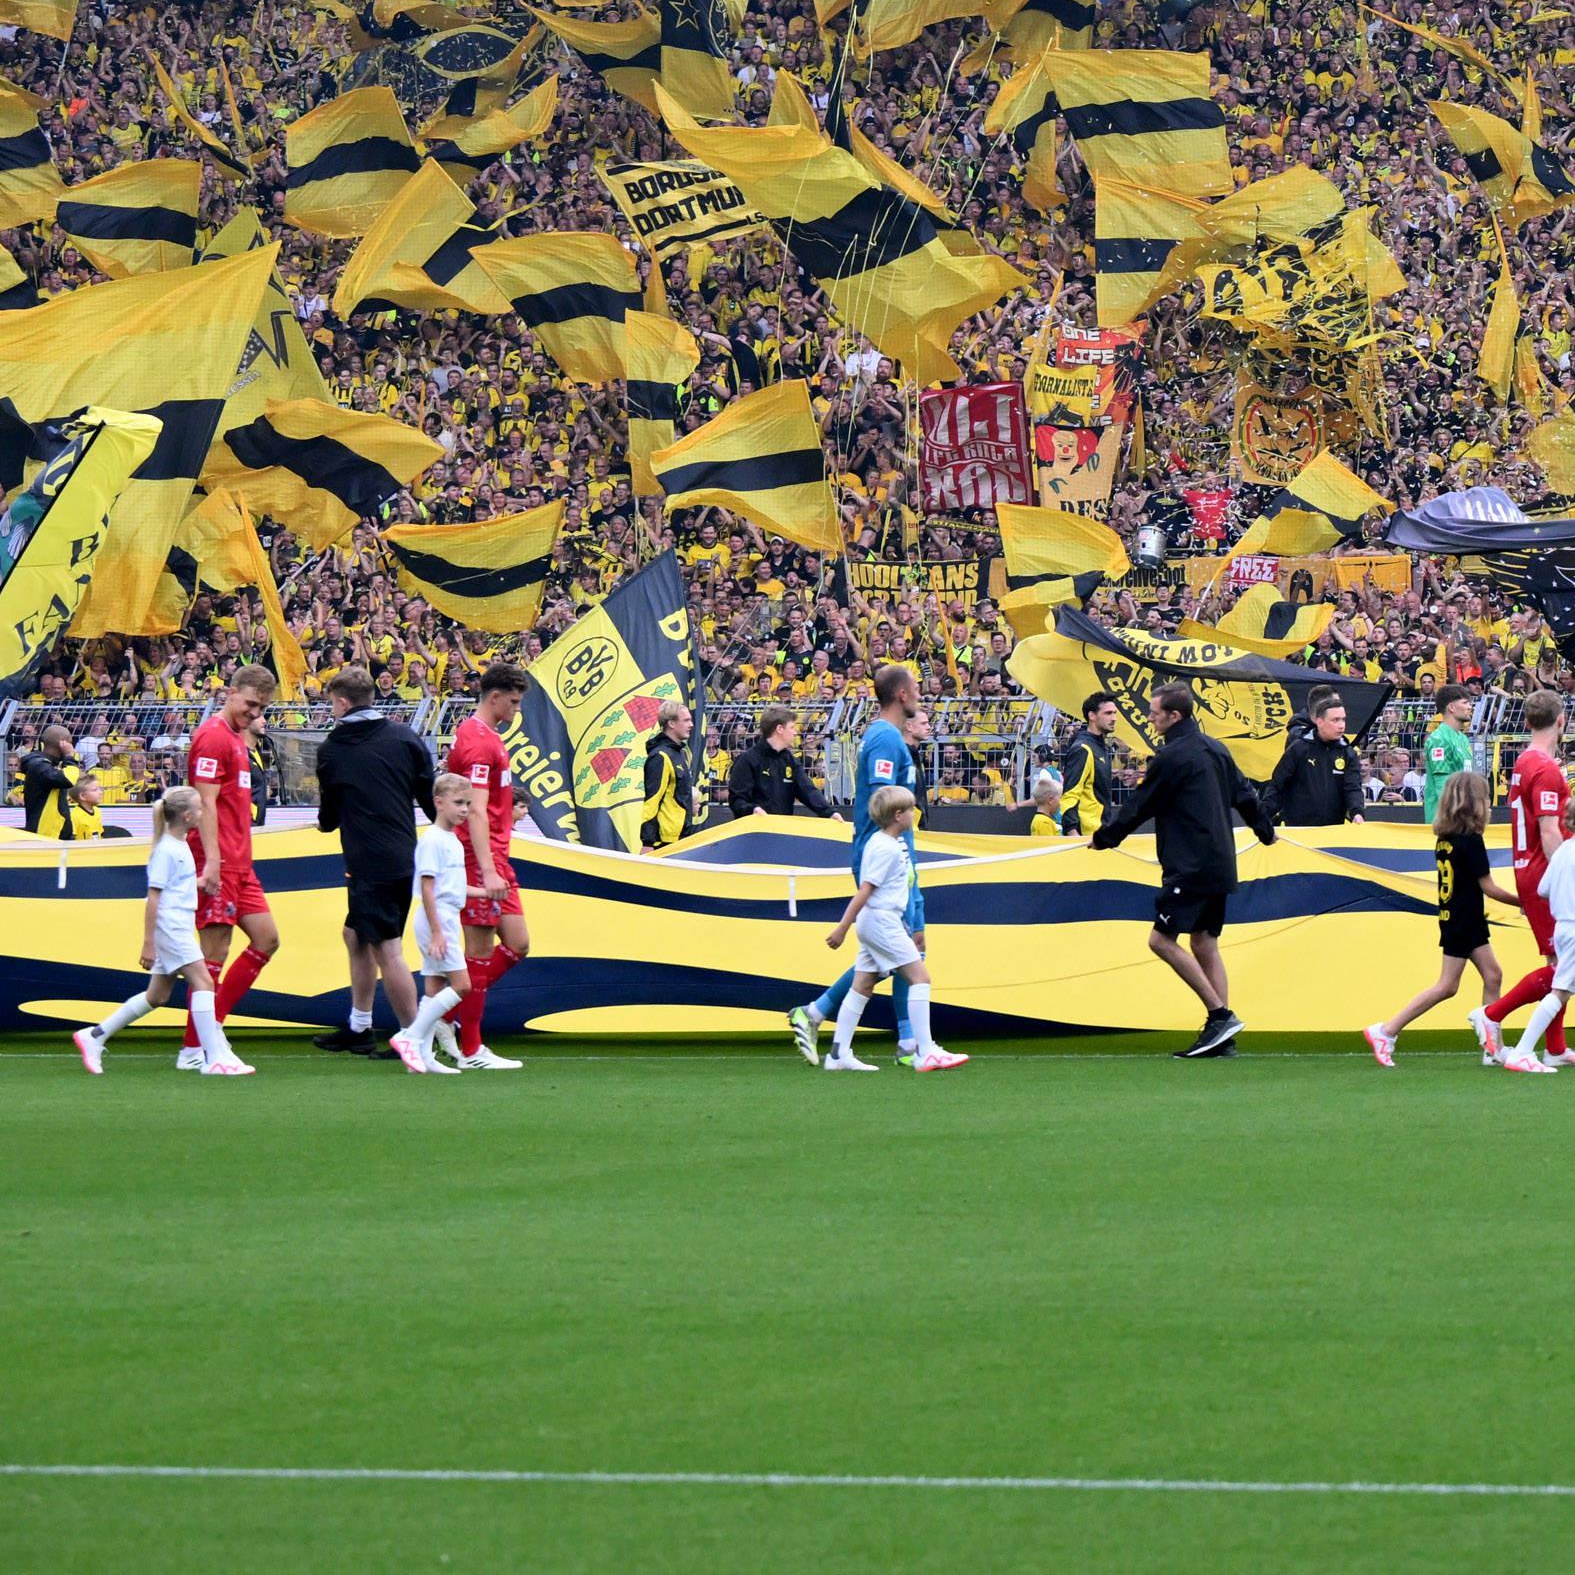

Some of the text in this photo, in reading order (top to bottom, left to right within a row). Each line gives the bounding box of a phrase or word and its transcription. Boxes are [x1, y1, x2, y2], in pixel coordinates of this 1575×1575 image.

[1063, 347, 1115, 364] LIFE
[849, 563, 980, 589] HOOLGANS
[1231, 557, 1277, 583] FREE
[565, 644, 614, 697] BVB
